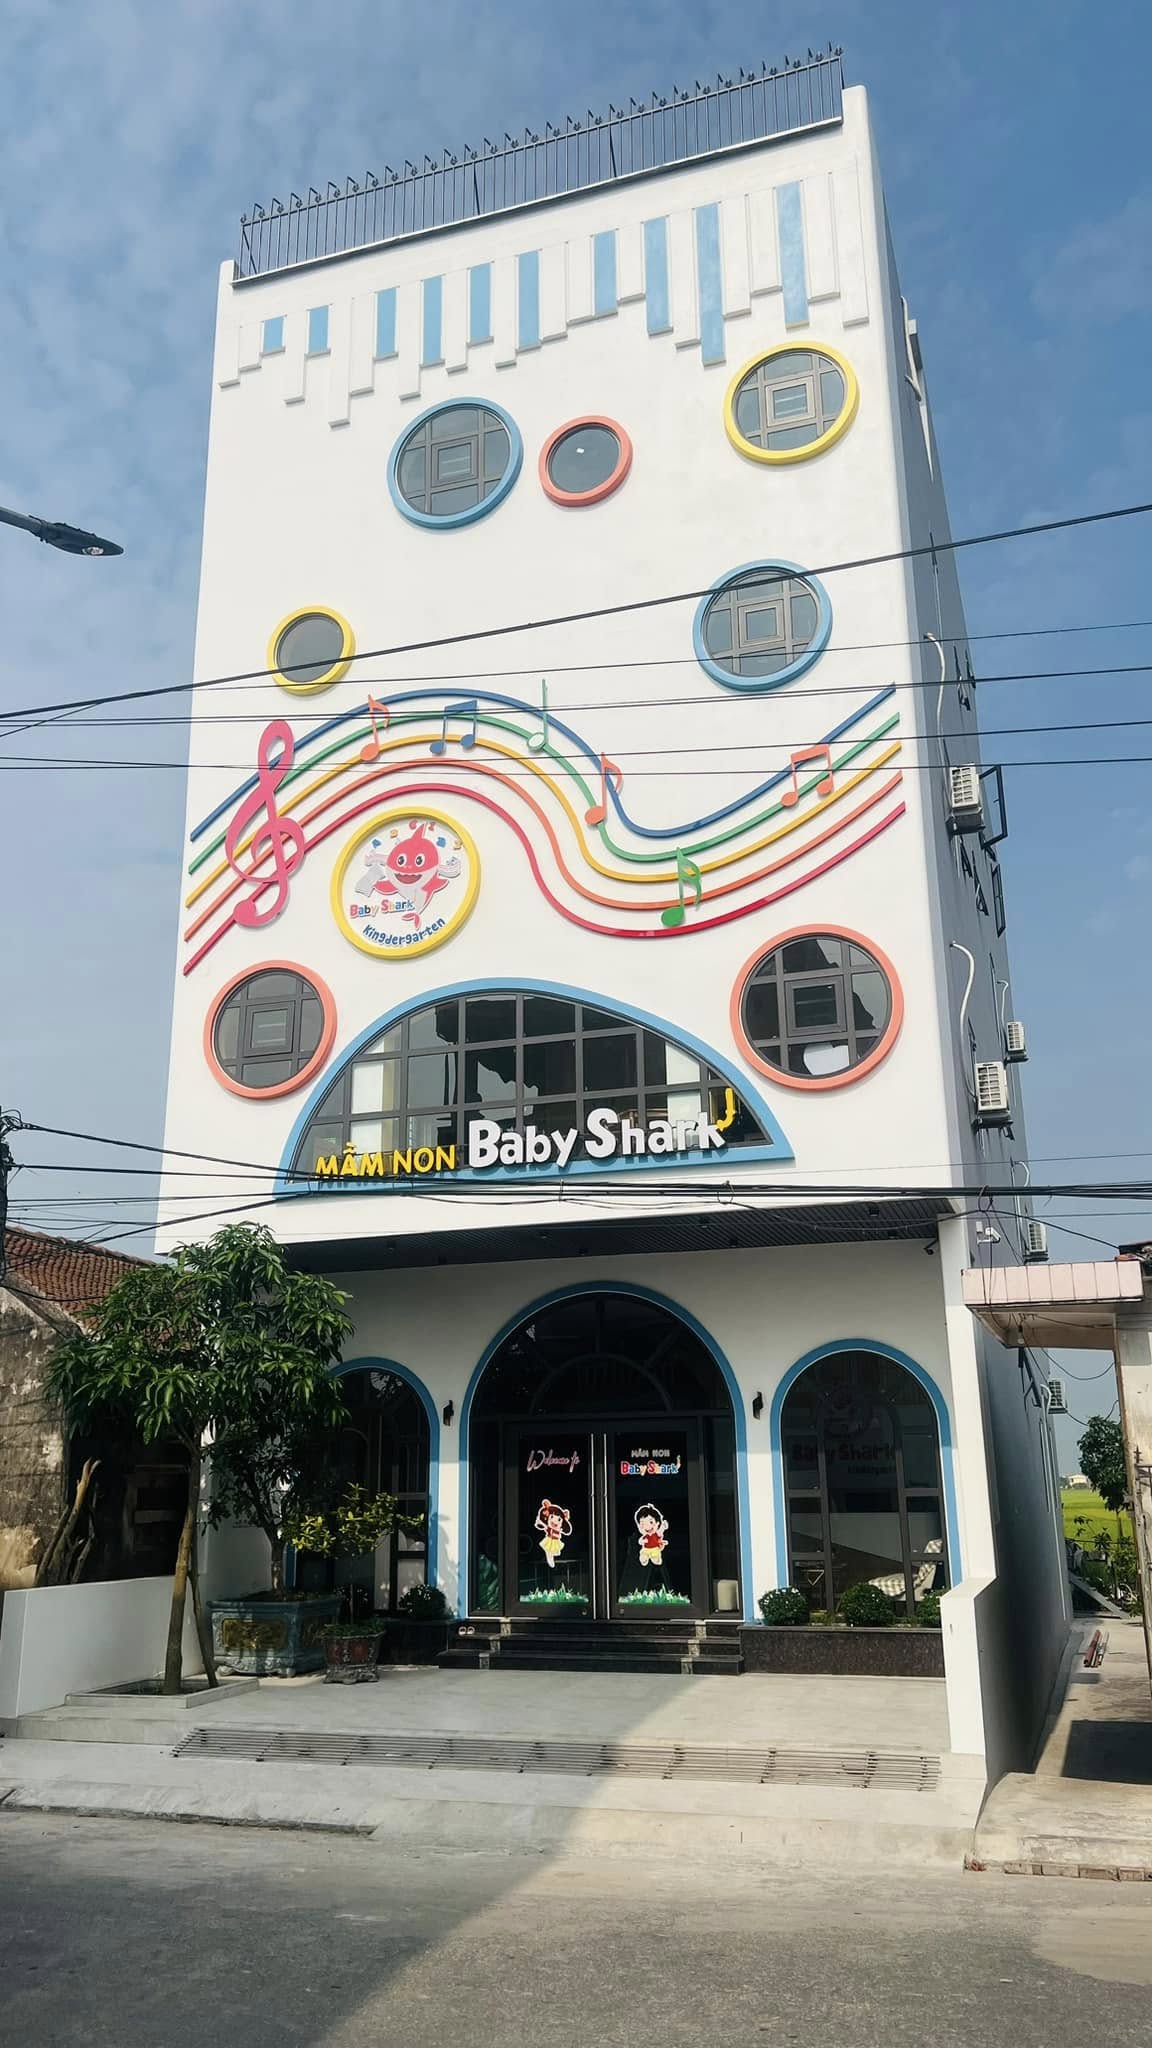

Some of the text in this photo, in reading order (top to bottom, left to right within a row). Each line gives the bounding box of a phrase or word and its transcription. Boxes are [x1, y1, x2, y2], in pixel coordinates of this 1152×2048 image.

[350, 899, 415, 919] Baby Shark
[393, 1144, 456, 1174] NON
[469, 1119, 578, 1168] Baby
[585, 1107, 726, 1158] Shark
[621, 1460, 679, 1476] Baby Shark
